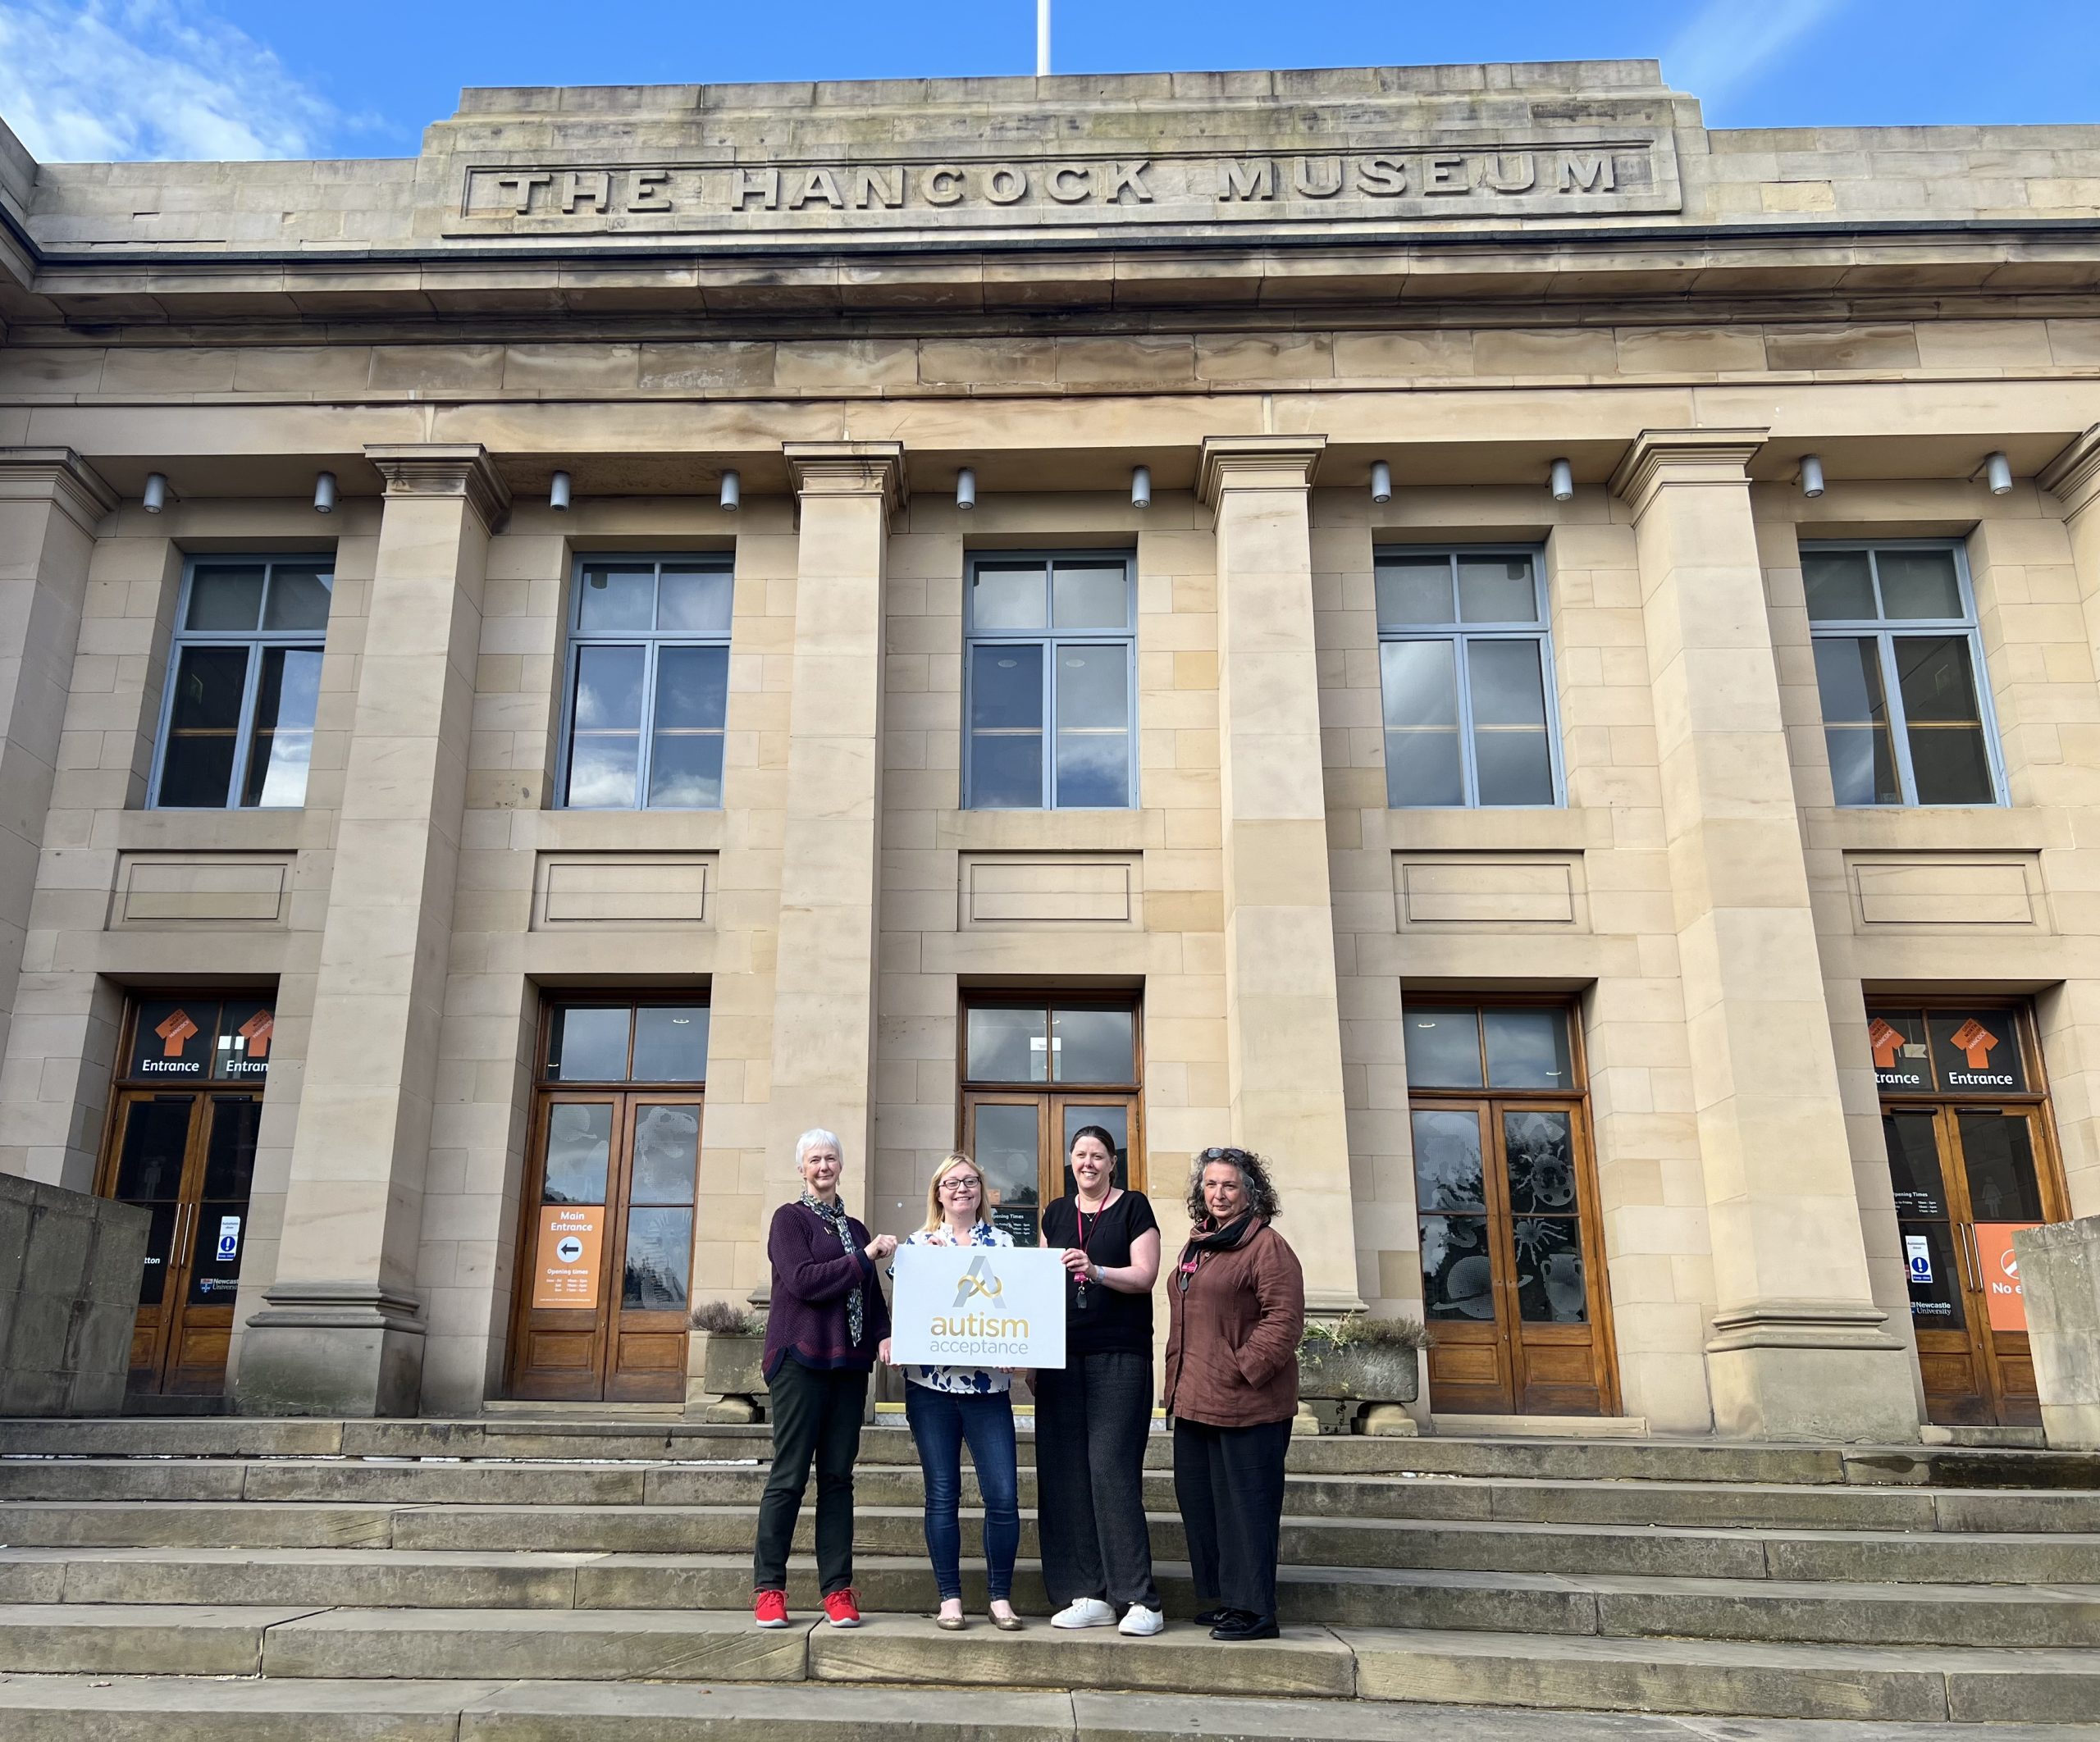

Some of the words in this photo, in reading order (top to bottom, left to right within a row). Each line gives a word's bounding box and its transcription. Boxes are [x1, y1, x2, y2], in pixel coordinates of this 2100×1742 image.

[499, 170, 673, 214] THE
[732, 161, 1153, 211] HANCOCK
[1218, 151, 1615, 201] MUSEUM
[1968, 1030, 1987, 1050] HANCOCK
[142, 1060, 200, 1072] Entrance
[1948, 1072, 2013, 1084] Entrance
[560, 1211, 584, 1220] Main
[550, 1222, 592, 1231] Entrance
[1993, 1282, 2011, 1294] No
[1916, 1307, 1952, 1316] University
[930, 1312, 1029, 1338] autism
[930, 1339, 1029, 1356] acceptance
